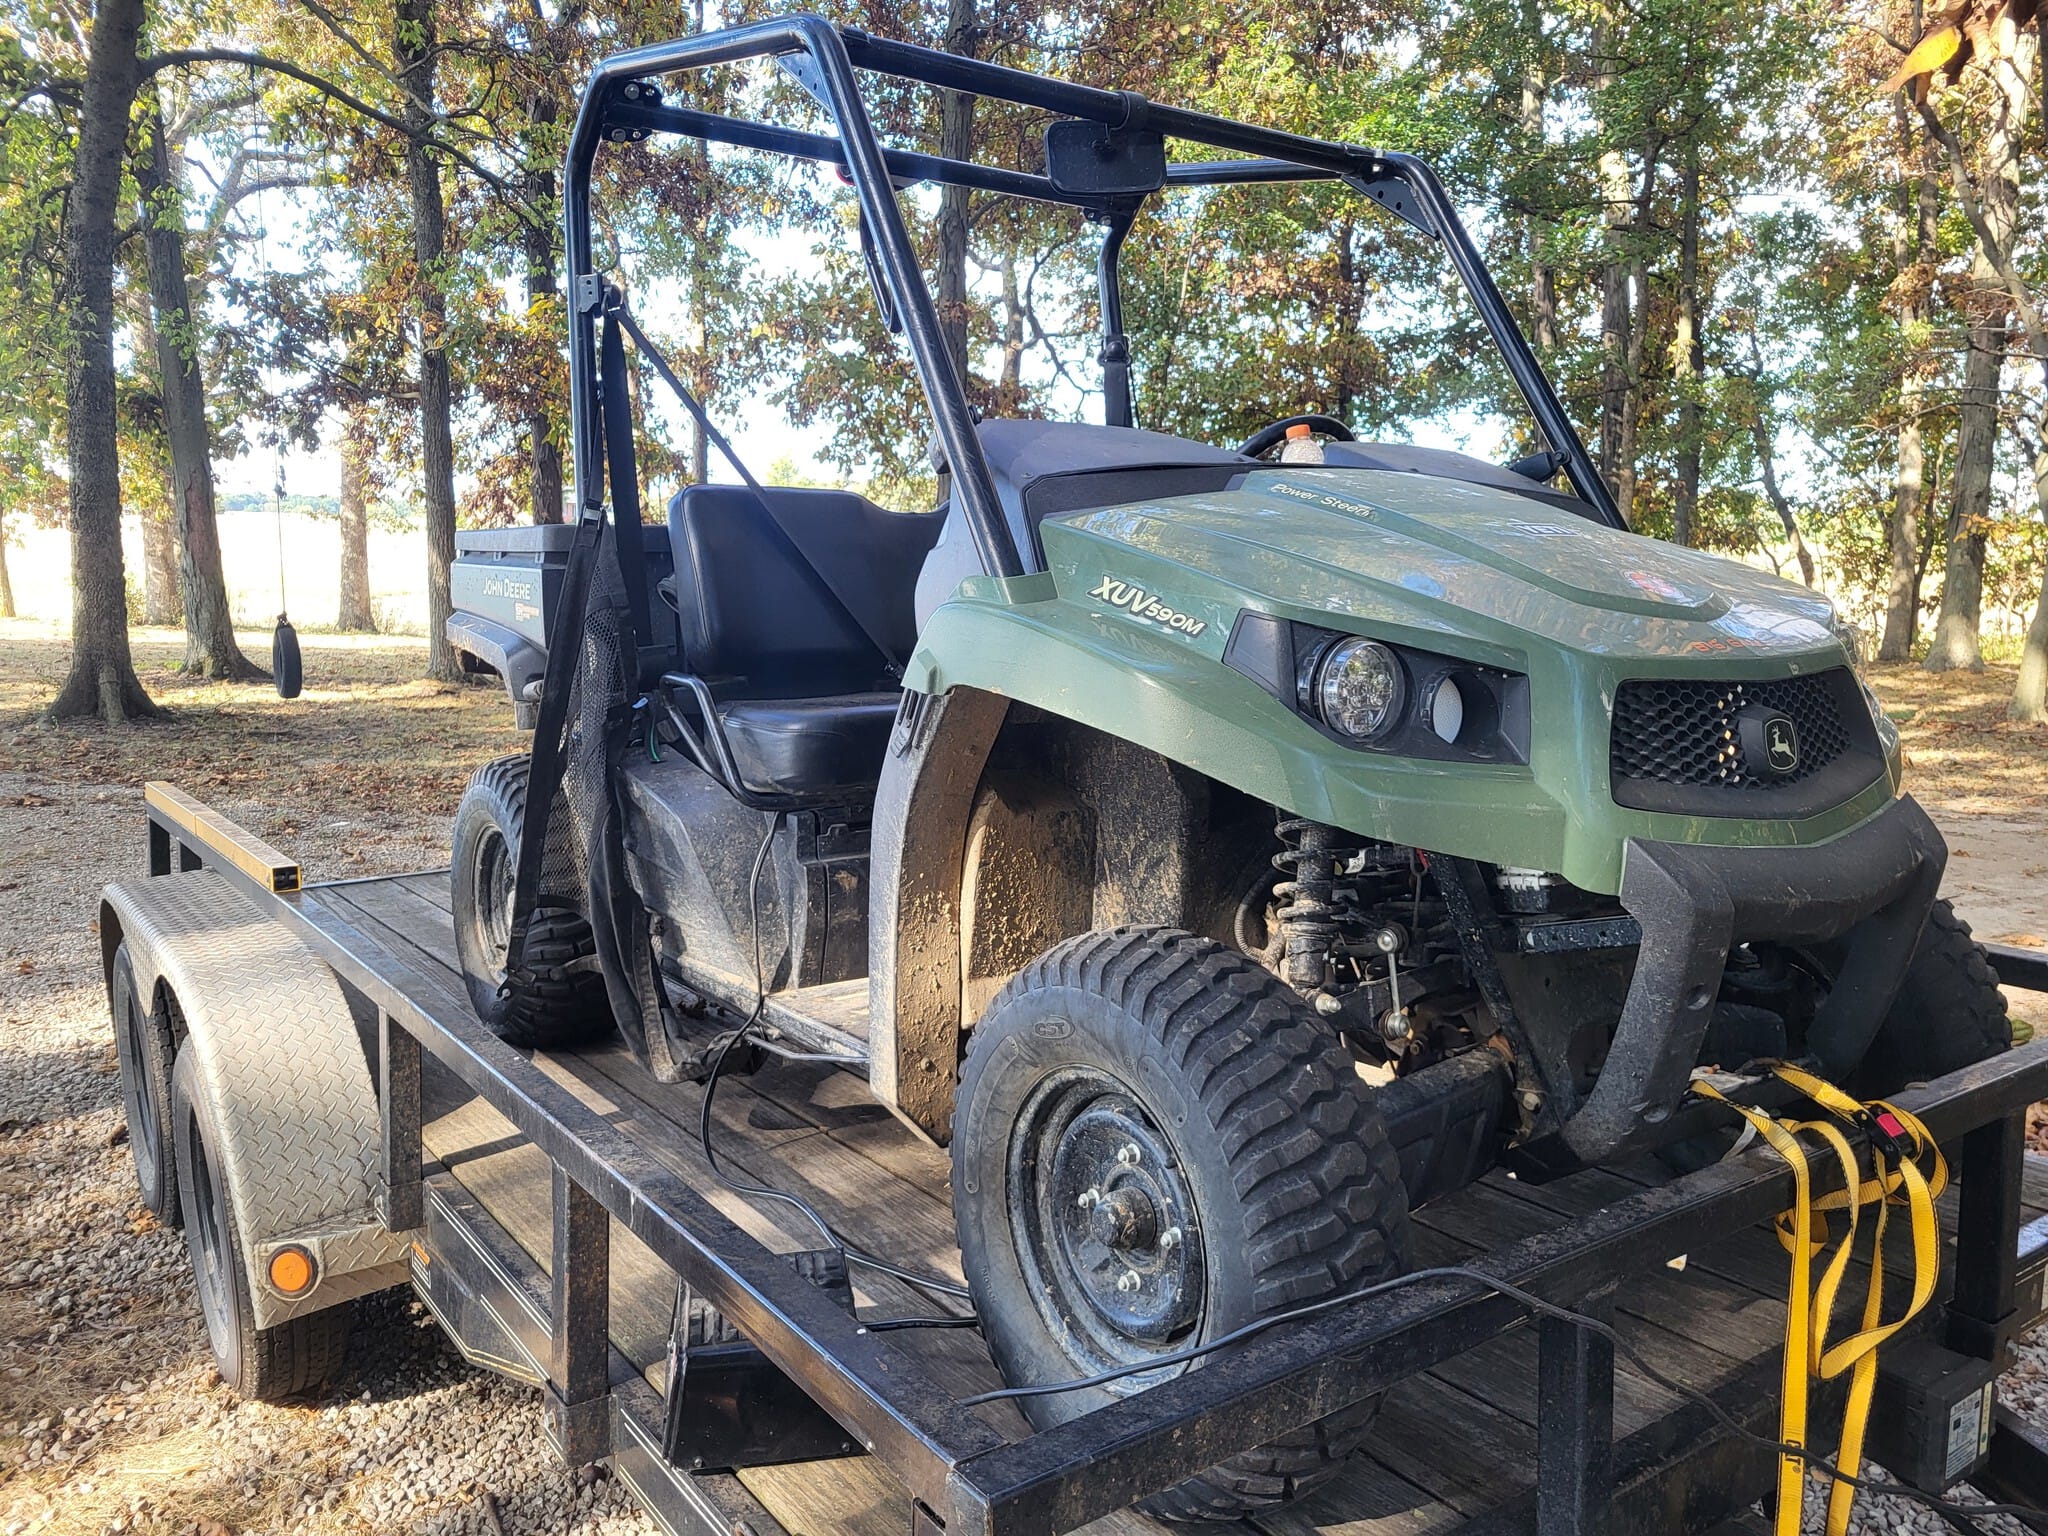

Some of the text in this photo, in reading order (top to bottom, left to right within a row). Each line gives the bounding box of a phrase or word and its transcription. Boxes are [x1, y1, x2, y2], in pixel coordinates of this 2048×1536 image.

[1270, 483, 1378, 521] Power Steeri
[1515, 524, 1575, 535] YETI
[482, 576, 531, 600] JOHN DEERE
[1088, 575, 1207, 637] XUV590M
[1034, 1022, 1065, 1036] CST
